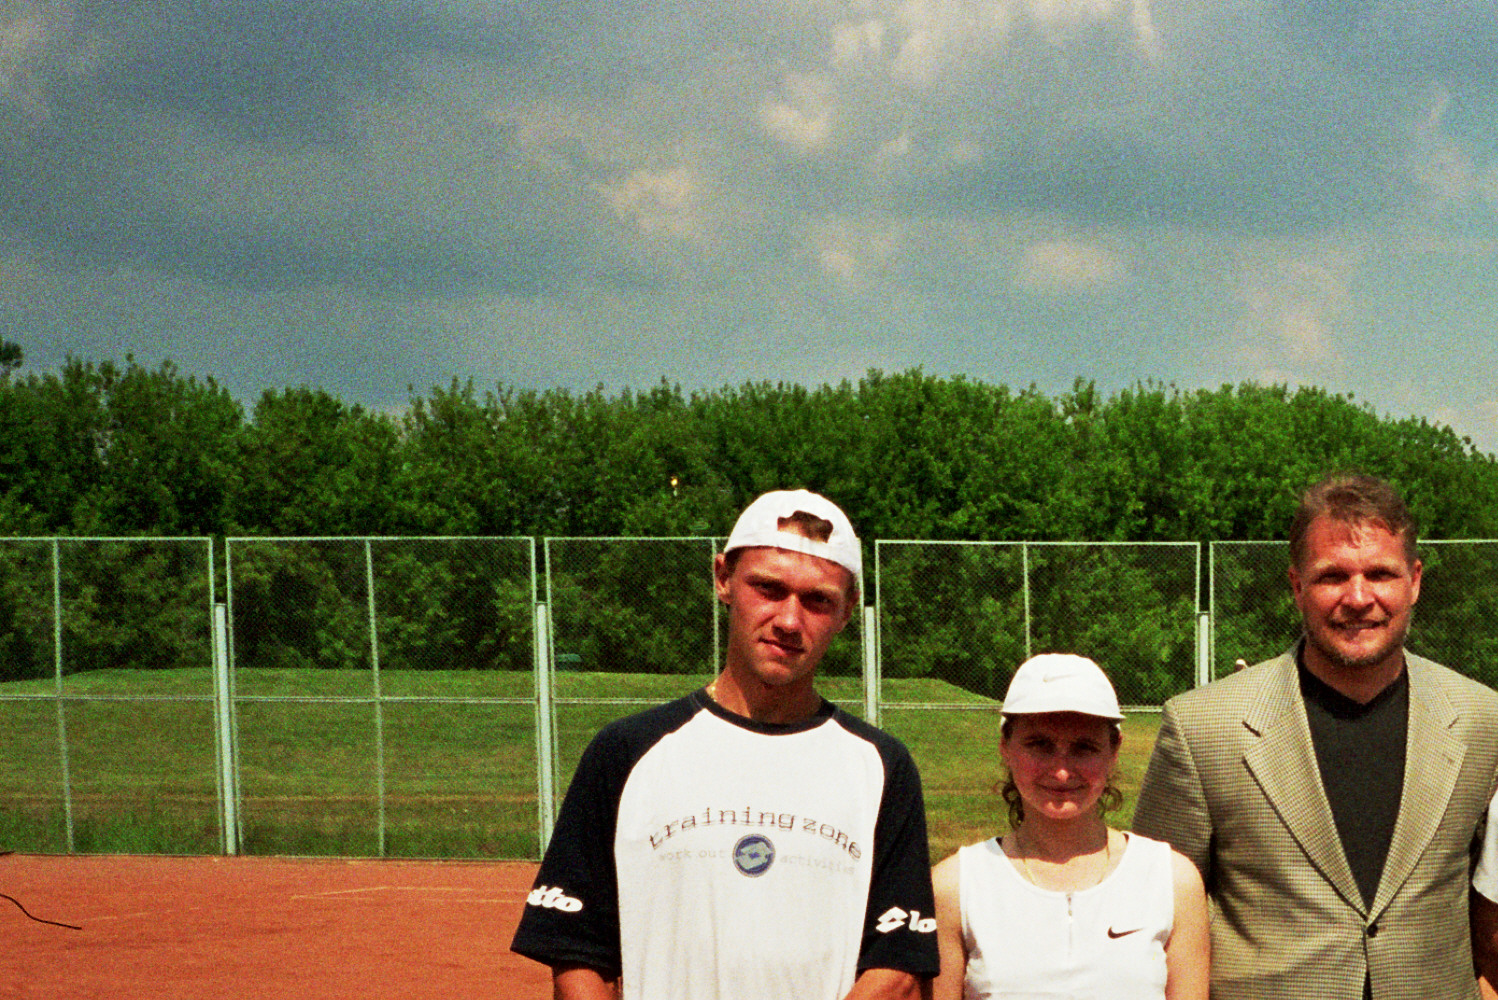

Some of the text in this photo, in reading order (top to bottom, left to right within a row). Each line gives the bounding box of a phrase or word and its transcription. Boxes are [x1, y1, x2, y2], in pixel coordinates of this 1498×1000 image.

[649, 806, 862, 861] training zone
[698, 848, 727, 859] out
